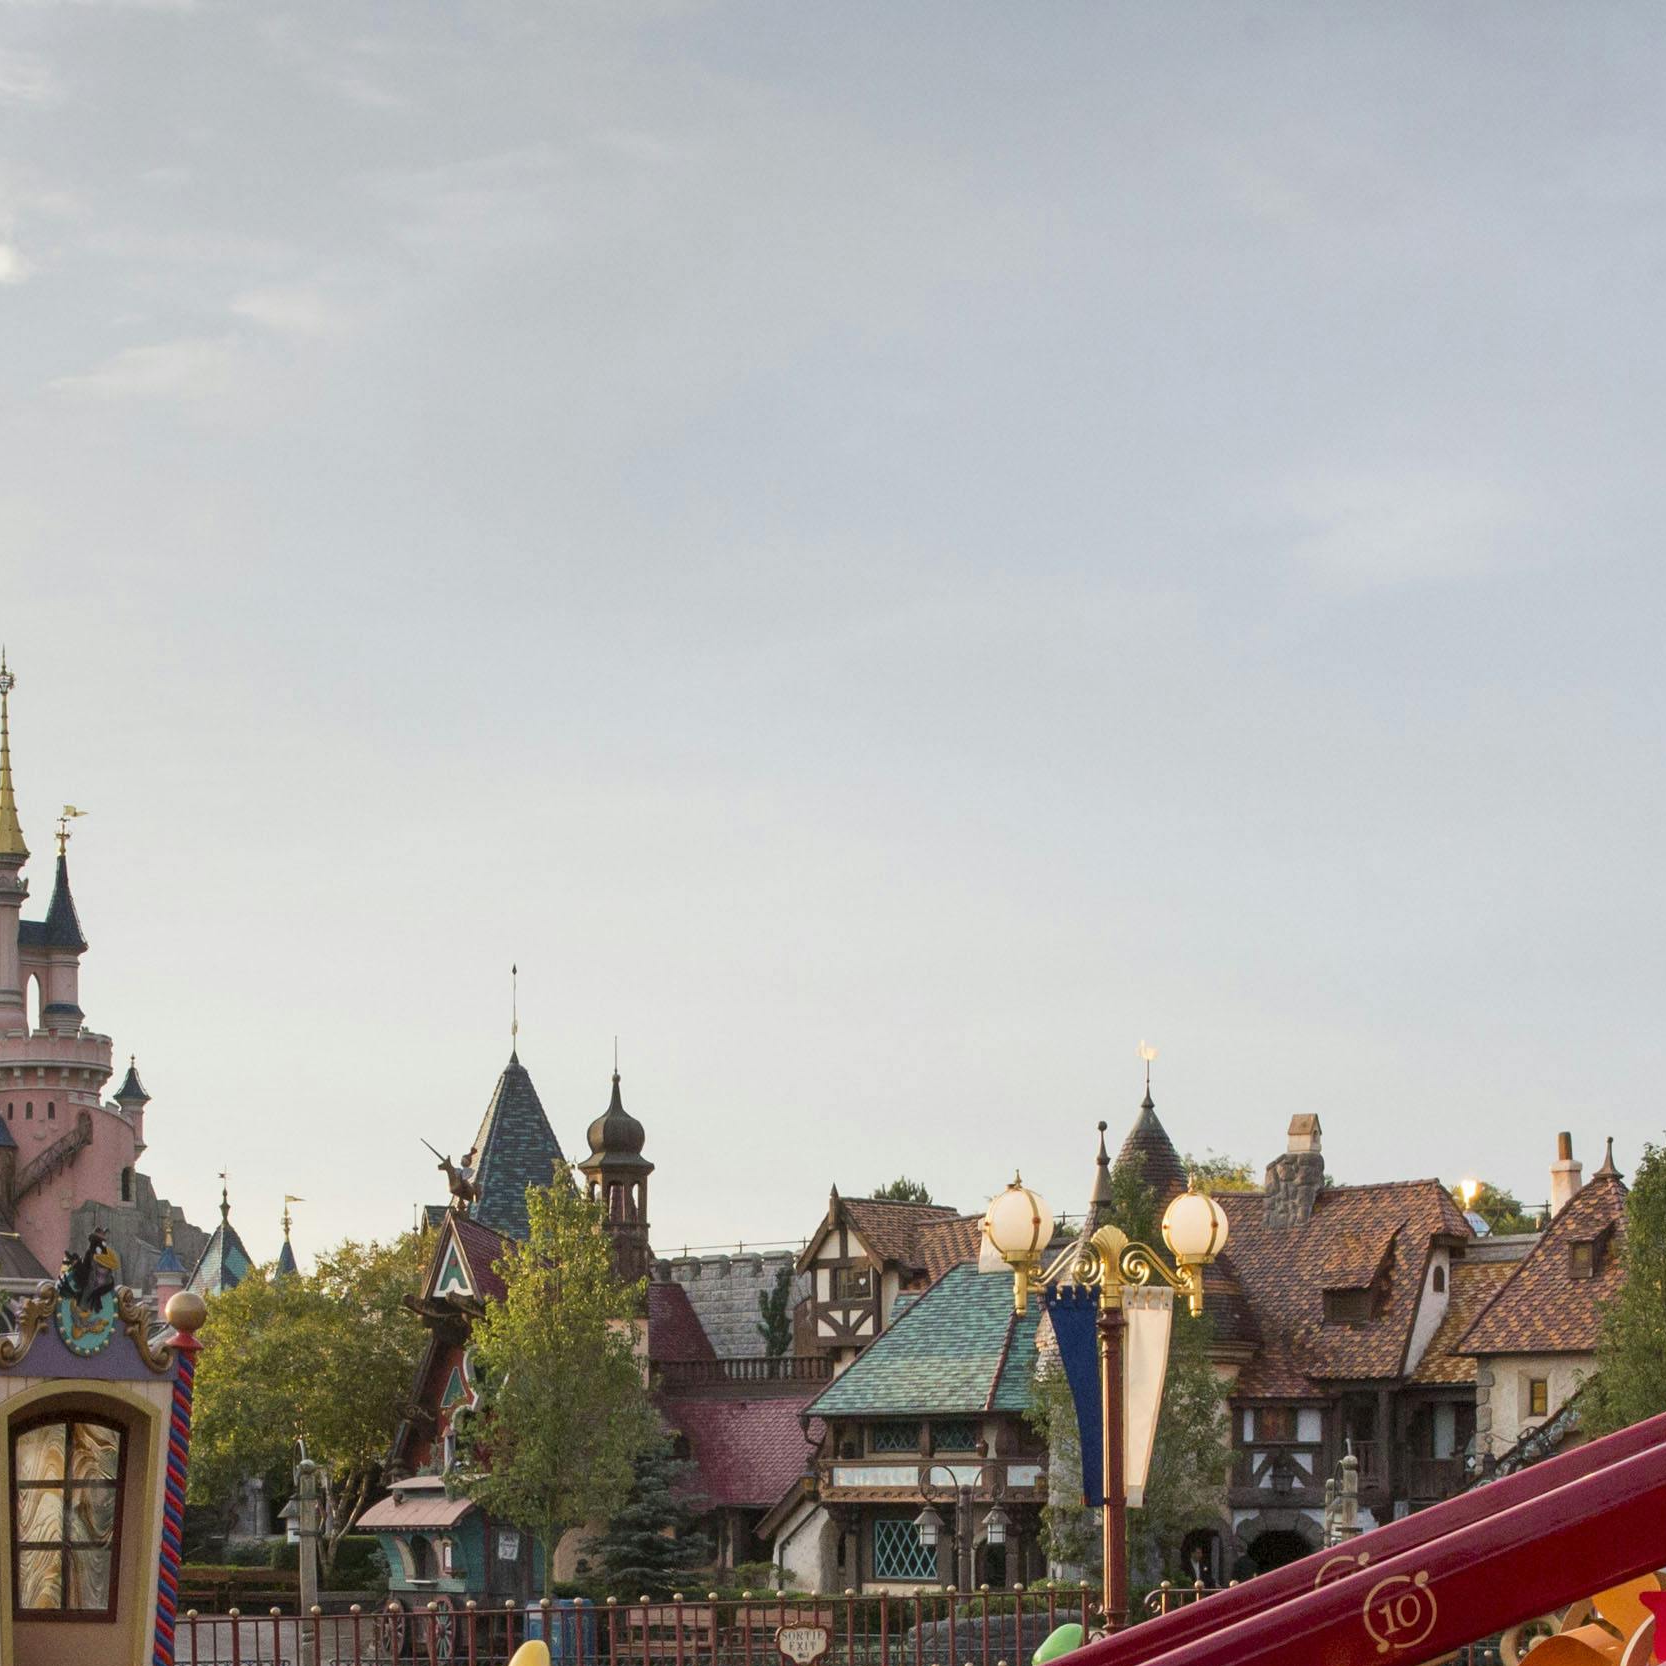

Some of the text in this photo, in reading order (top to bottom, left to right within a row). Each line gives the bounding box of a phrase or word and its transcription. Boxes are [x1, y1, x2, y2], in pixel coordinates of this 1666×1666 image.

[1378, 1594, 1421, 1636] 10
[781, 1631, 824, 1640] SORTIE
[788, 1641, 817, 1651] EXIT
